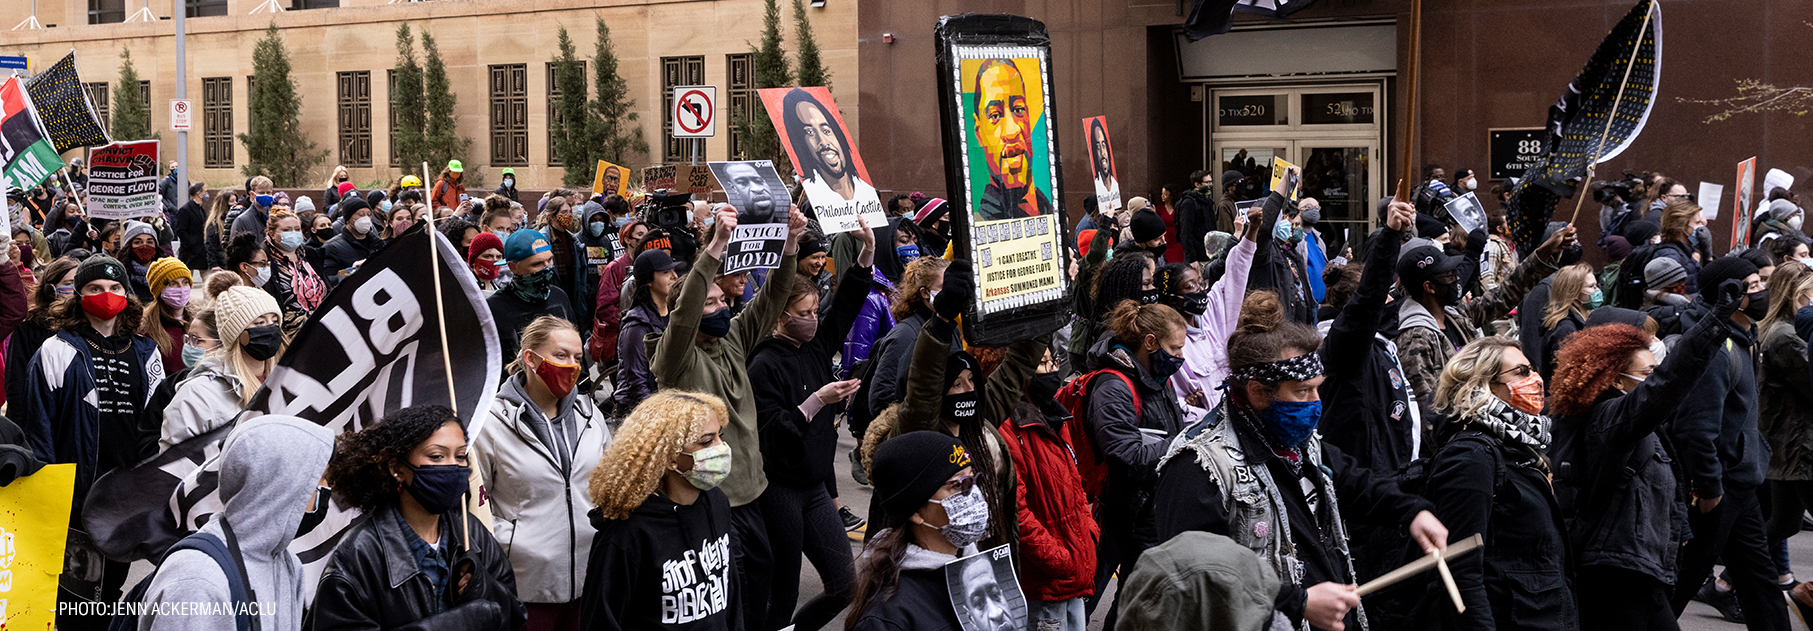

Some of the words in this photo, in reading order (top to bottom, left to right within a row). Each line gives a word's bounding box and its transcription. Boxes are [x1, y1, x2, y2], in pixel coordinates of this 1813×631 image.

[1243, 104, 1265, 116] 520
[93, 147, 135, 157] CONVICT
[1517, 139, 1542, 154] 88
[92, 155, 136, 164] CHAUVIN
[90, 170, 126, 179] JUSTICE
[127, 170, 145, 178] FOR
[688, 173, 709, 182] COPS
[90, 184, 126, 194] GEORGE
[127, 182, 156, 194] FLOYD
[687, 183, 714, 193] GUILTY
[690, 179, 708, 188] ARE
[125, 194, 156, 204] COMMUNITY
[128, 201, 143, 209] OVER
[814, 202, 854, 220] Philando
[855, 200, 882, 215] Castile
[731, 226, 784, 242] JUSTICE
[744, 242, 761, 250] FOR
[727, 252, 778, 271] FLOYD
[1002, 253, 1016, 265] CANT
[986, 269, 1006, 283] JUSTICE
[1006, 268, 1017, 279] FOR
[1017, 264, 1036, 277] GEORGE
[1035, 262, 1052, 274] FLOYD
[985, 286, 1010, 298] Arkansas
[1010, 279, 1039, 293] SUMMONED
[1038, 275, 1055, 288] MAMA
[955, 400, 977, 409] CONV
[954, 408, 976, 417] CHAU
[661, 549, 697, 594] STOP
[661, 581, 712, 624] BLACK
